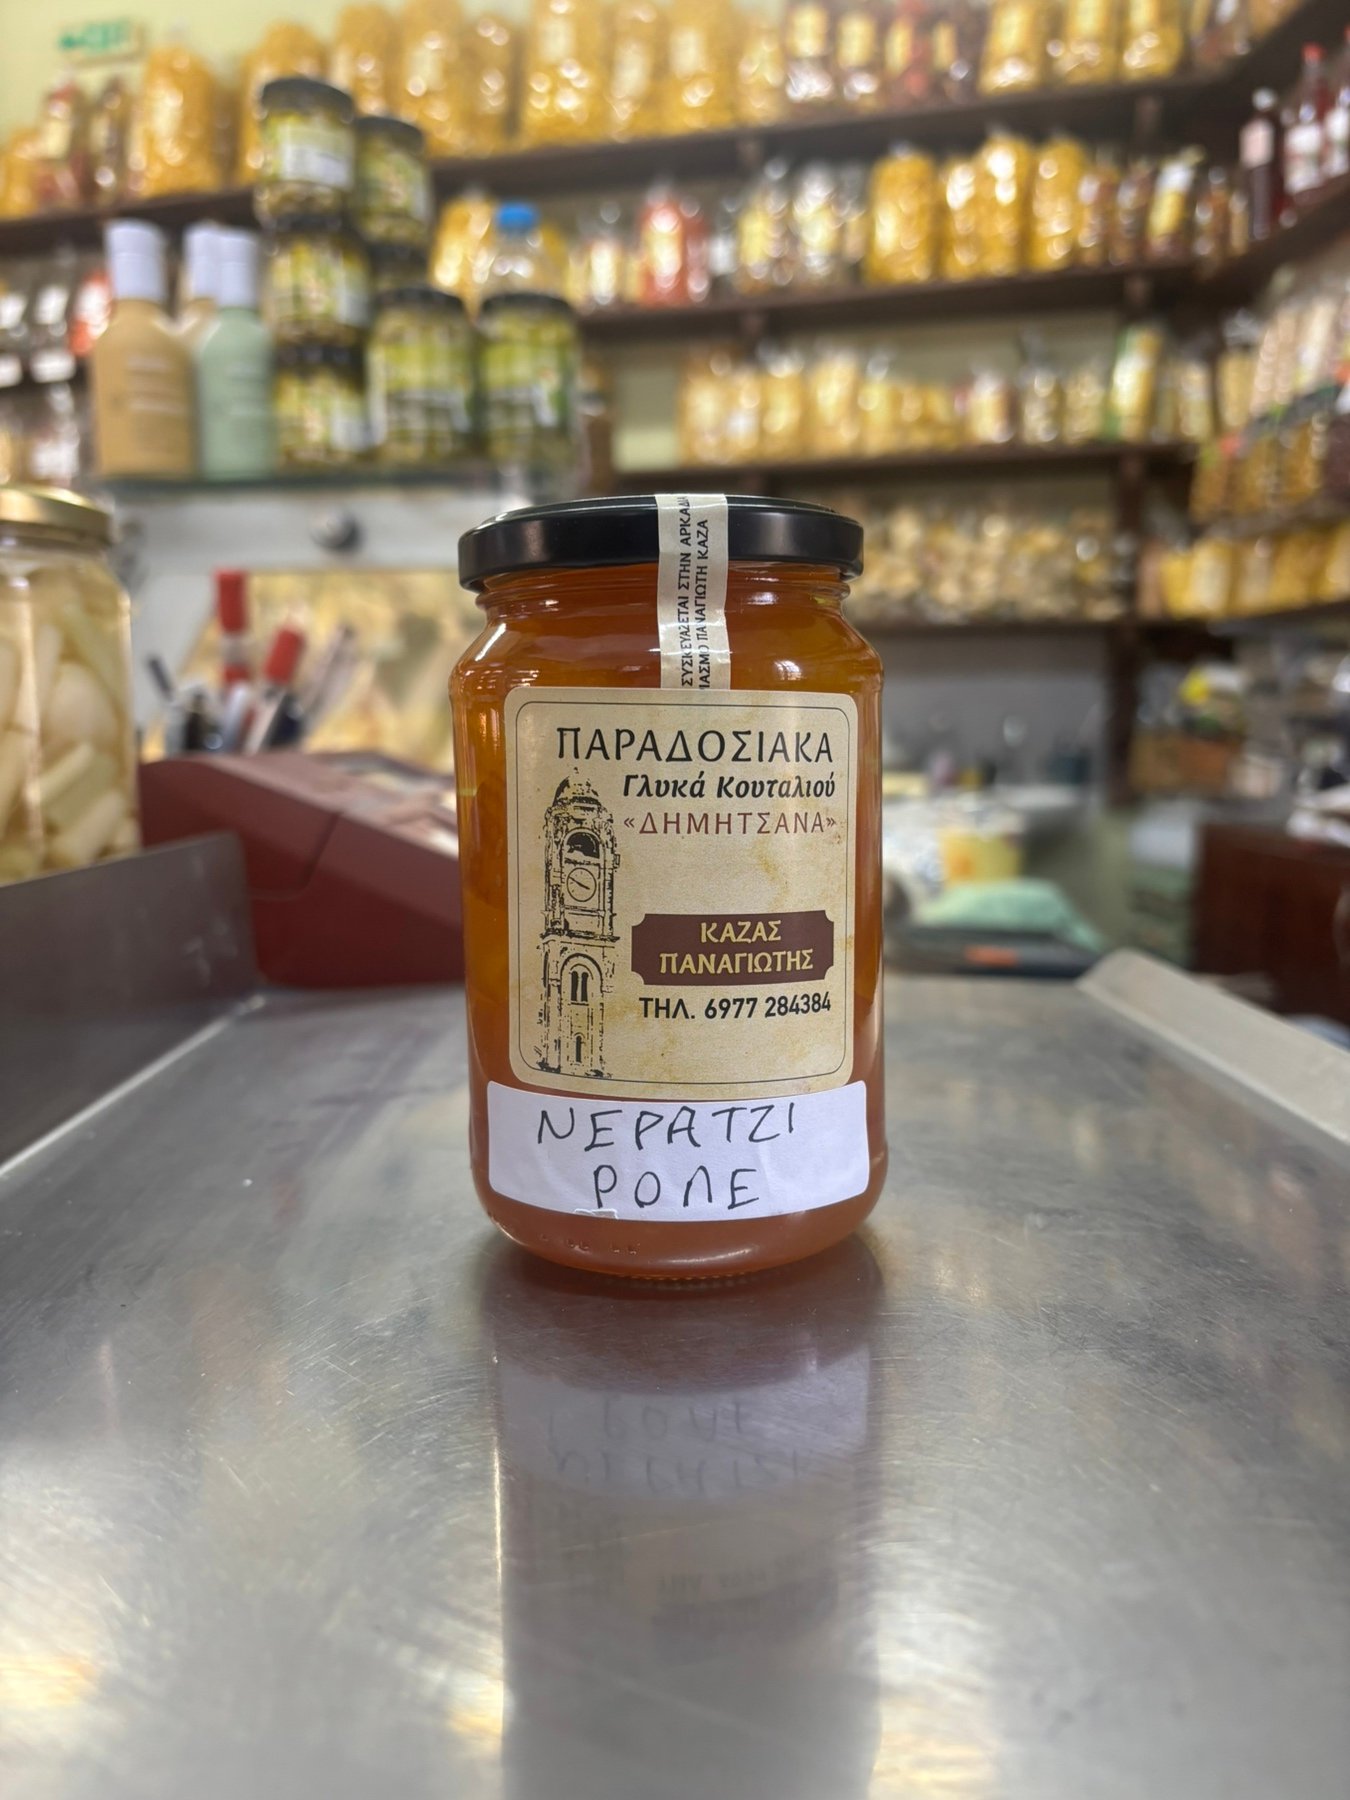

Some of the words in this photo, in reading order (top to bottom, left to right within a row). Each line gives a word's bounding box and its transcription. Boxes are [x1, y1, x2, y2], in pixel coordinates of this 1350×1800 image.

[697, 520, 709, 560] ΚΑΖΑ
[678, 552, 691, 590] ΣΤΗΝ
[694, 565, 708, 641] ΠΑΝΑΓΙΩΤΗ
[677, 596, 693, 687] ΣΥΣΚΕΥΑΖΕΤΑΙ
[698, 644, 710, 689] ΙΑΣΜΟ
[557, 727, 833, 763] ΠΑΡΑΔΟΣΙΑΚΑ
[622, 771, 705, 799] Γλυκά
[716, 773, 836, 799] Κουταλιού
[623, 811, 837, 835] «ΔΗΜΗΤΣΑΝΑ»
[700, 920, 782, 943] ΚΑΖΑΣ
[659, 948, 814, 975] ΠΑΝΑΓΙΩΤΗΣ
[638, 997, 696, 1020] ΤΗΛ.
[704, 996, 759, 1019] 6977
[764, 991, 832, 1018] 284384
[537, 1102, 795, 1152] ΝΕΡΑΤΖΙ
[593, 1164, 760, 1210] ΡΟΛΕ
